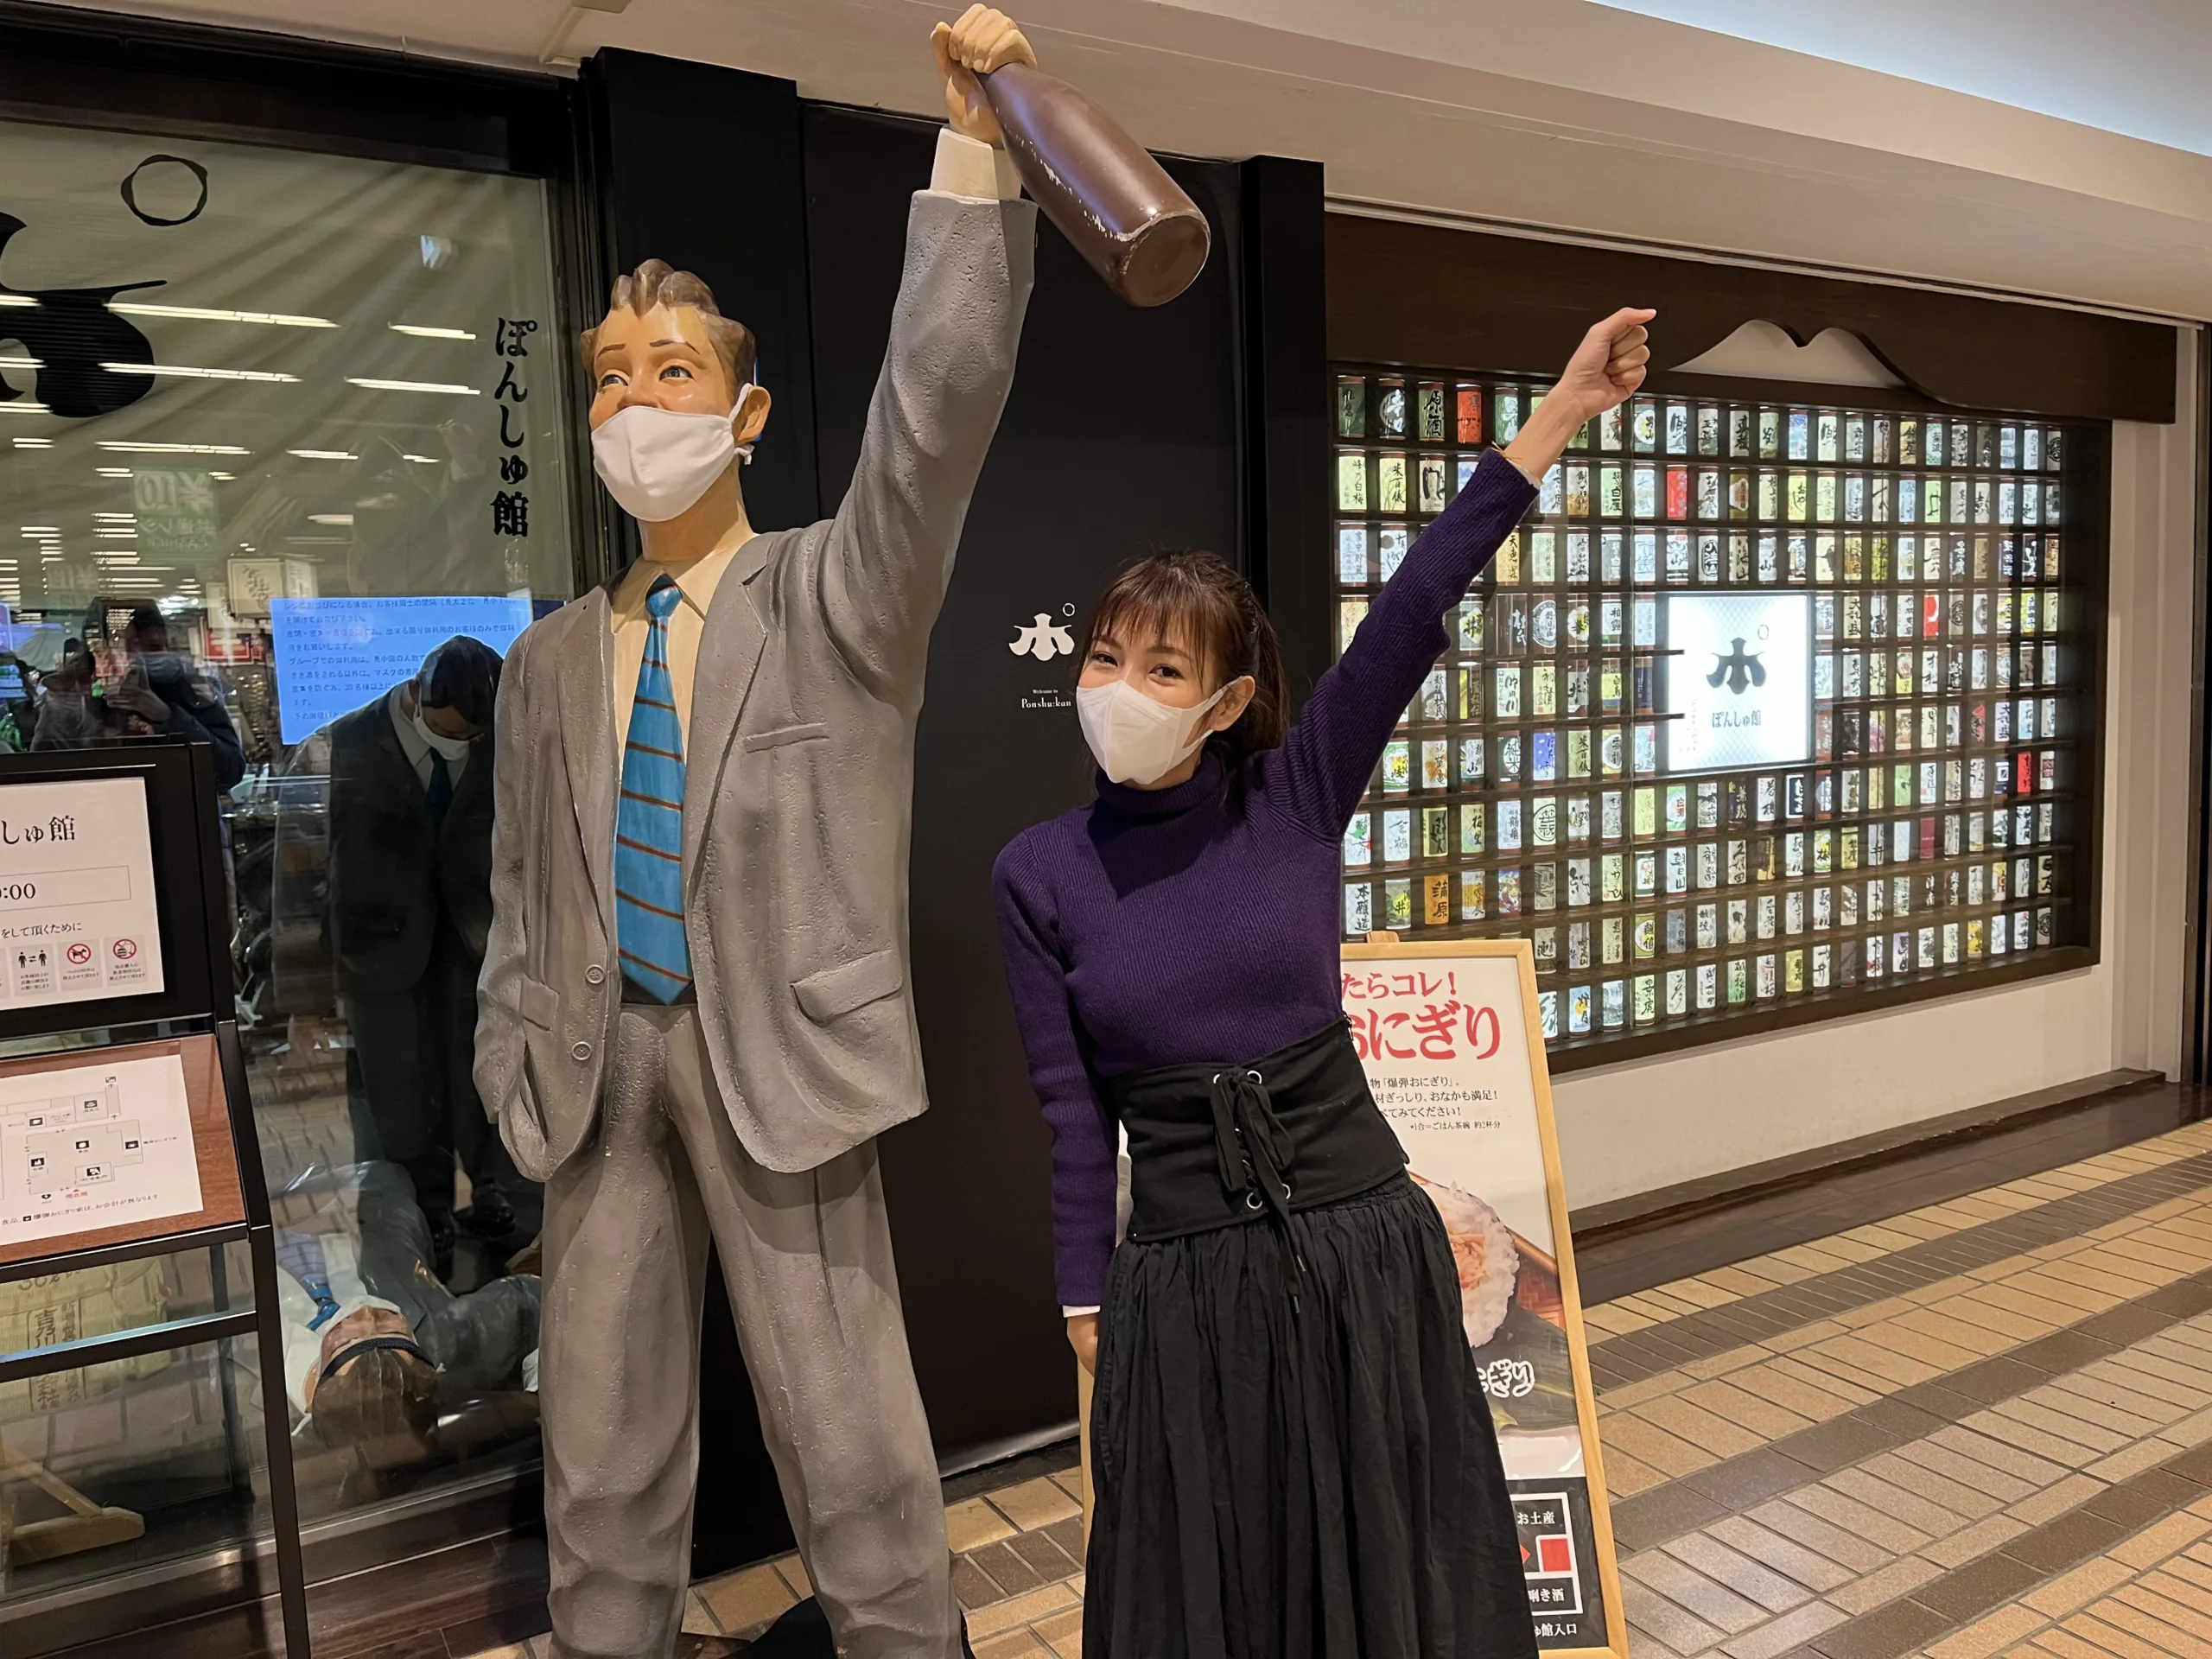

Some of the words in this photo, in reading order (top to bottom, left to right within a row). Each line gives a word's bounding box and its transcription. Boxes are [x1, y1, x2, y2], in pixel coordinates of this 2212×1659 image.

[490, 317, 537, 537] ぽんしゅ館
[1712, 709, 1761, 728] ぽんしゅ館
[1, 815, 76, 845] しゅ館
[0, 883, 35, 899] :00
[2, 923, 82, 938] をして頂くために
[1341, 972, 1458, 1000] たらコレ！
[1370, 1077, 1460, 1089] 物「爆弾おにぎり」。
[1376, 1090, 1497, 1103] 材ぎっしり、おなかも満足！
[1517, 1511, 1555, 1525] お土産
